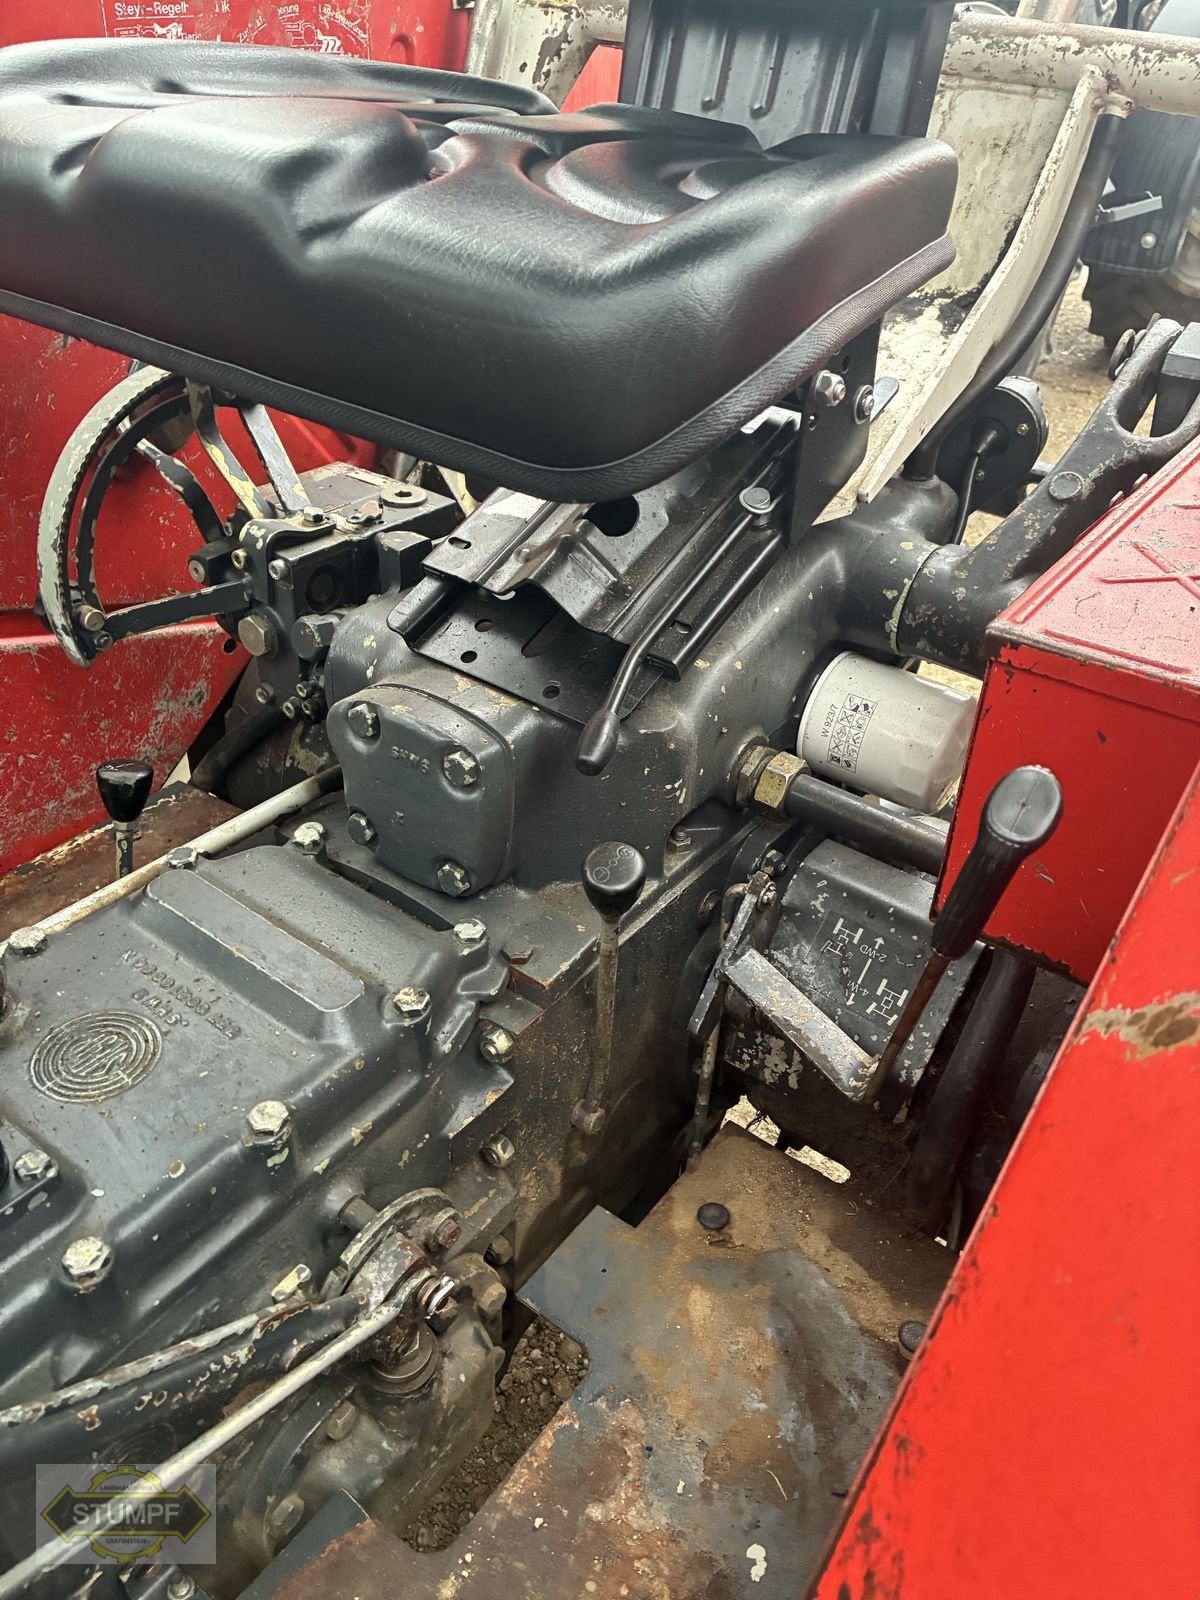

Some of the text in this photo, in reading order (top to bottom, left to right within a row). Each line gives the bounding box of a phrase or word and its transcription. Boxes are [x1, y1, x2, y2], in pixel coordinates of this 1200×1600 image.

[821, 703, 839, 739] W 923/7
[859, 944, 887, 963] 2-WD
